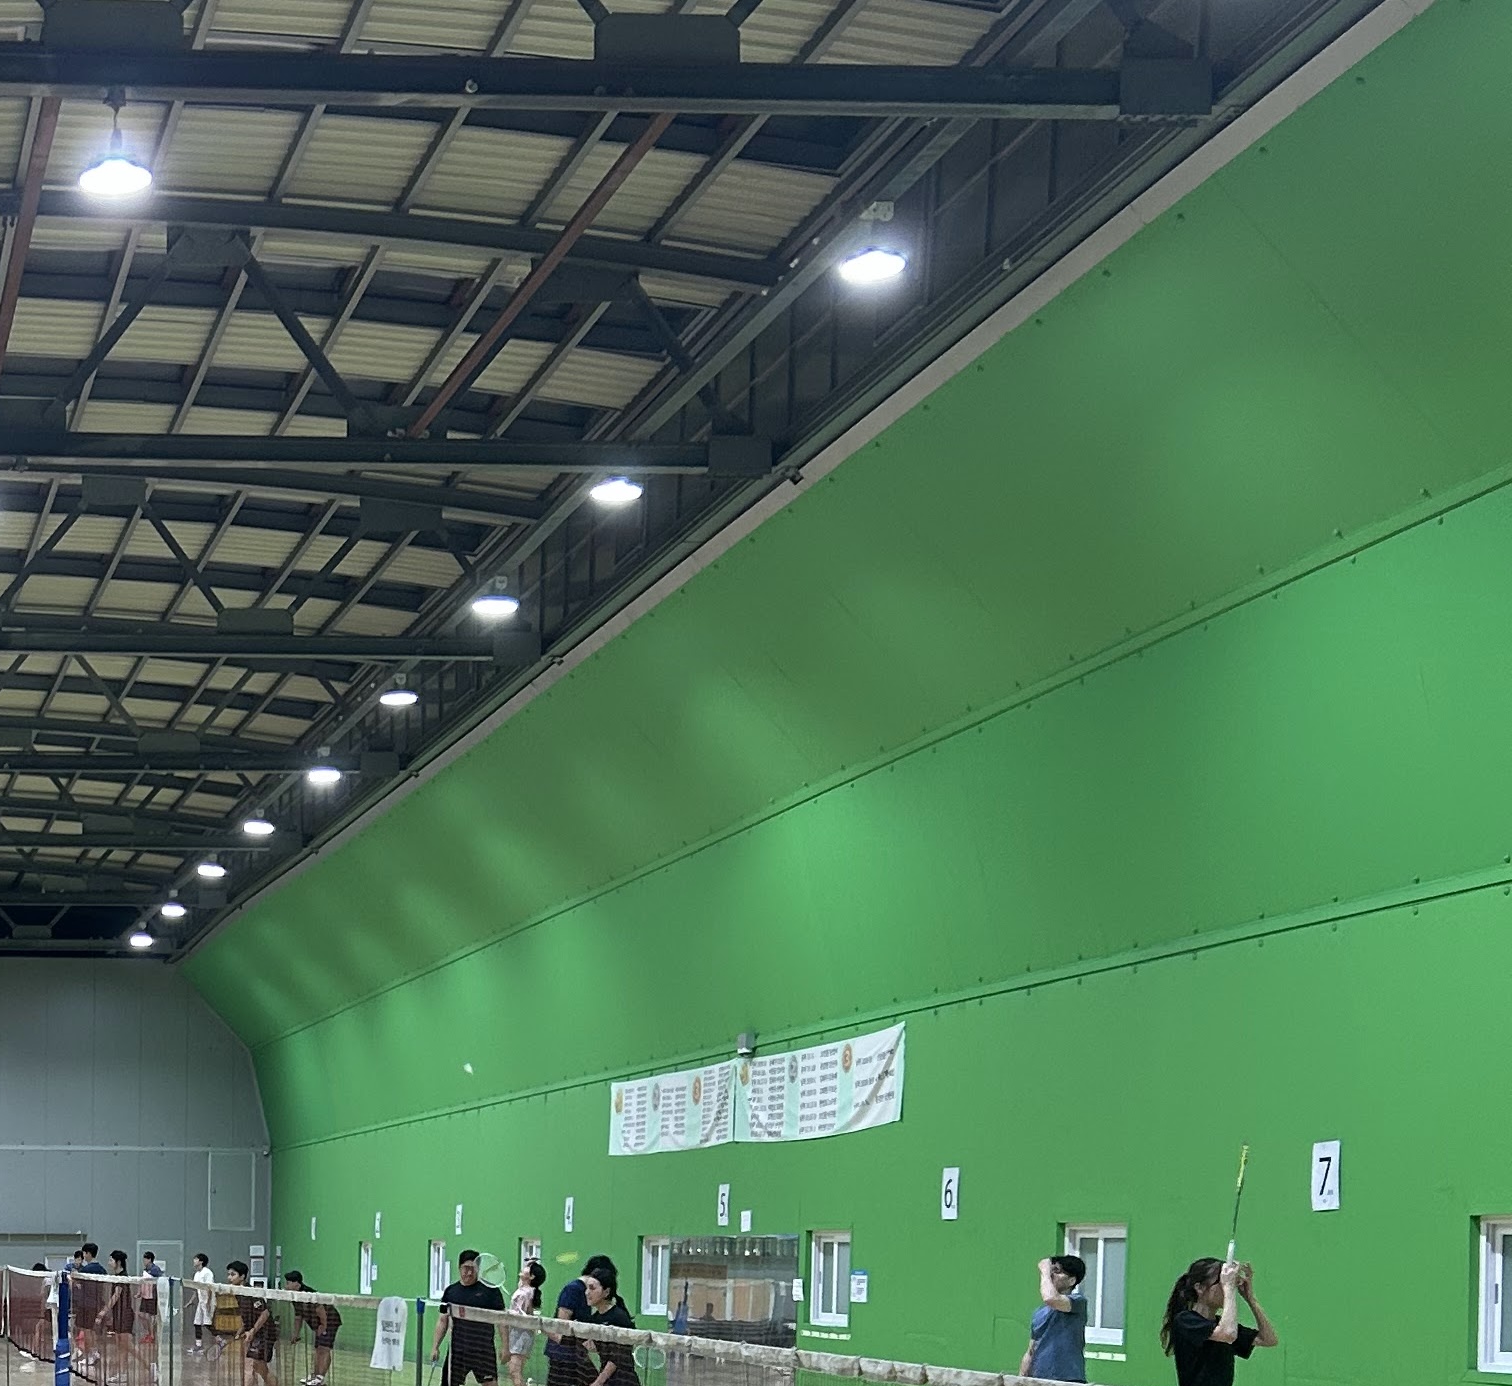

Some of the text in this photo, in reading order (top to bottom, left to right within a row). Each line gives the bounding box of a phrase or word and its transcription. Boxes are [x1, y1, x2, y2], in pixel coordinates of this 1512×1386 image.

[1318, 1156, 1332, 1196] 7
[719, 1192, 726, 1217] 5
[944, 1178, 953, 1209] 6
